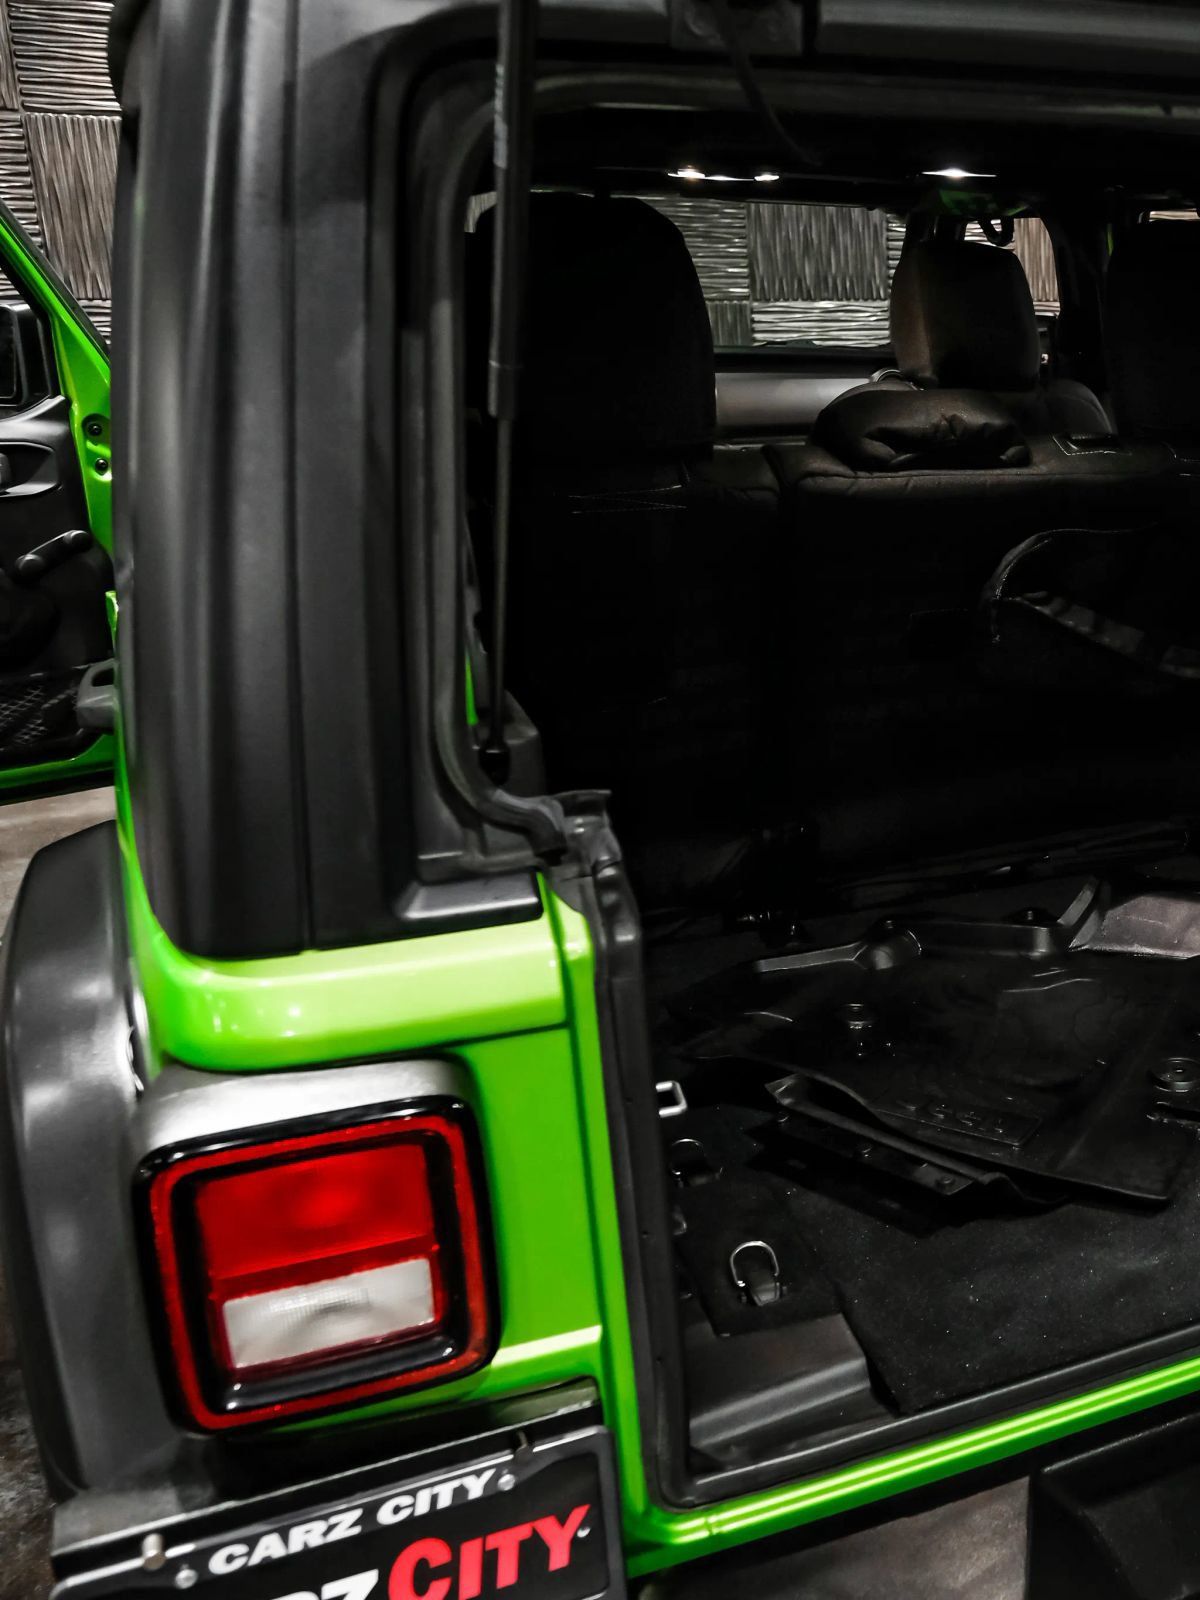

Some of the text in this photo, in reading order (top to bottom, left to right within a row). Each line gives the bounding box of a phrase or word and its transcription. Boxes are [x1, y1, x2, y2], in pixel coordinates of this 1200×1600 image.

[208, 1468, 499, 1575] CARZ CITY
[388, 1504, 591, 1600] CITY
